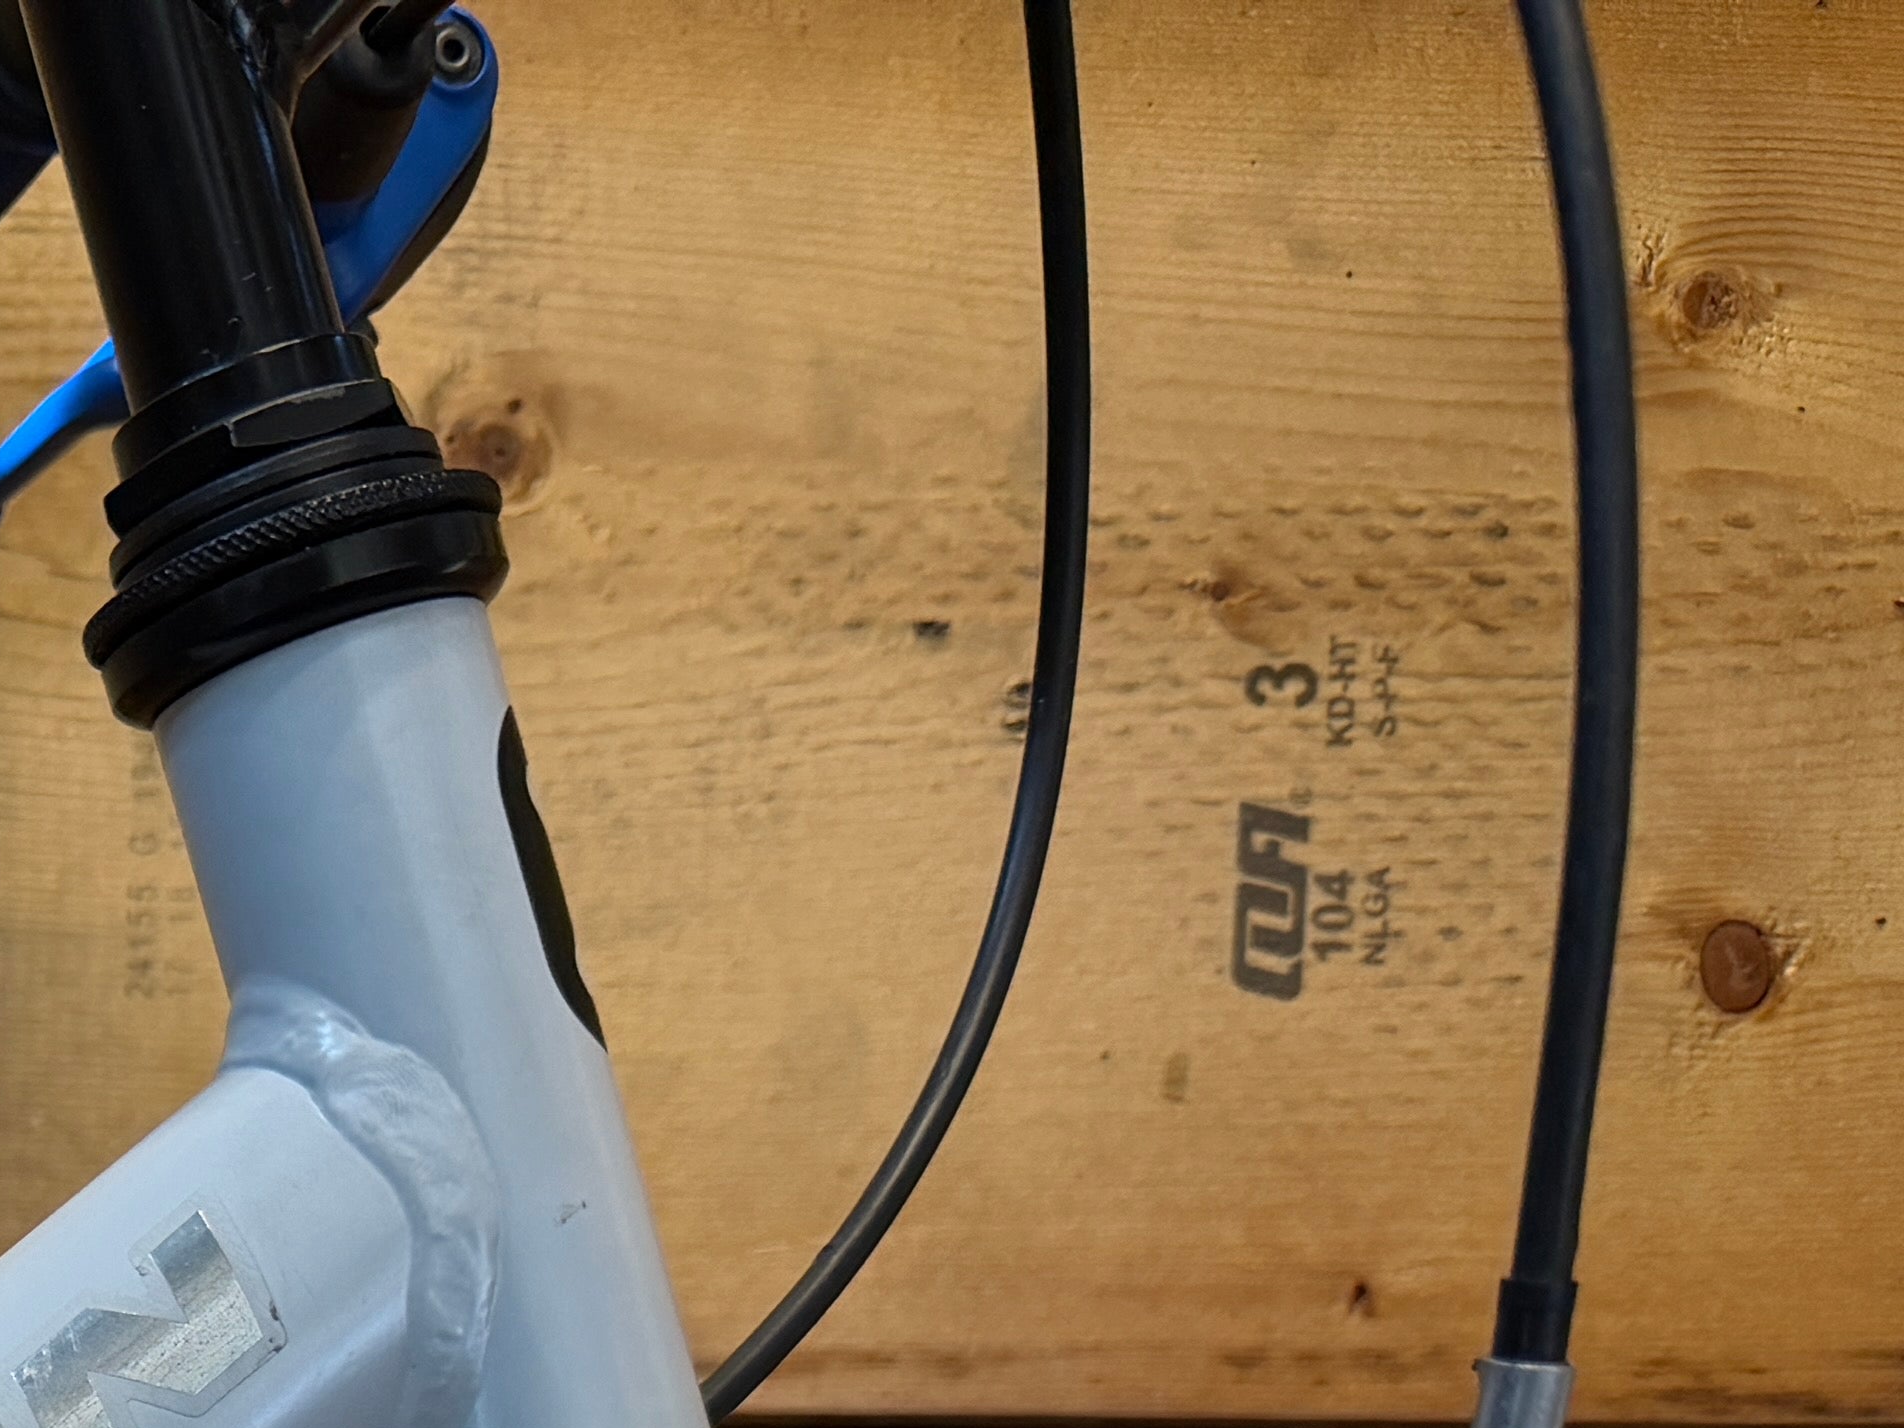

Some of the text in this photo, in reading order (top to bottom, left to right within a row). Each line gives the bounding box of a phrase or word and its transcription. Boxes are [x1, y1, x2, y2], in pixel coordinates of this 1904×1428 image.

[1244, 662, 1319, 709] 3
[1325, 634, 1361, 748] KD-HT
[1310, 867, 1357, 963] 104
[1359, 866, 1397, 966] NLGA
